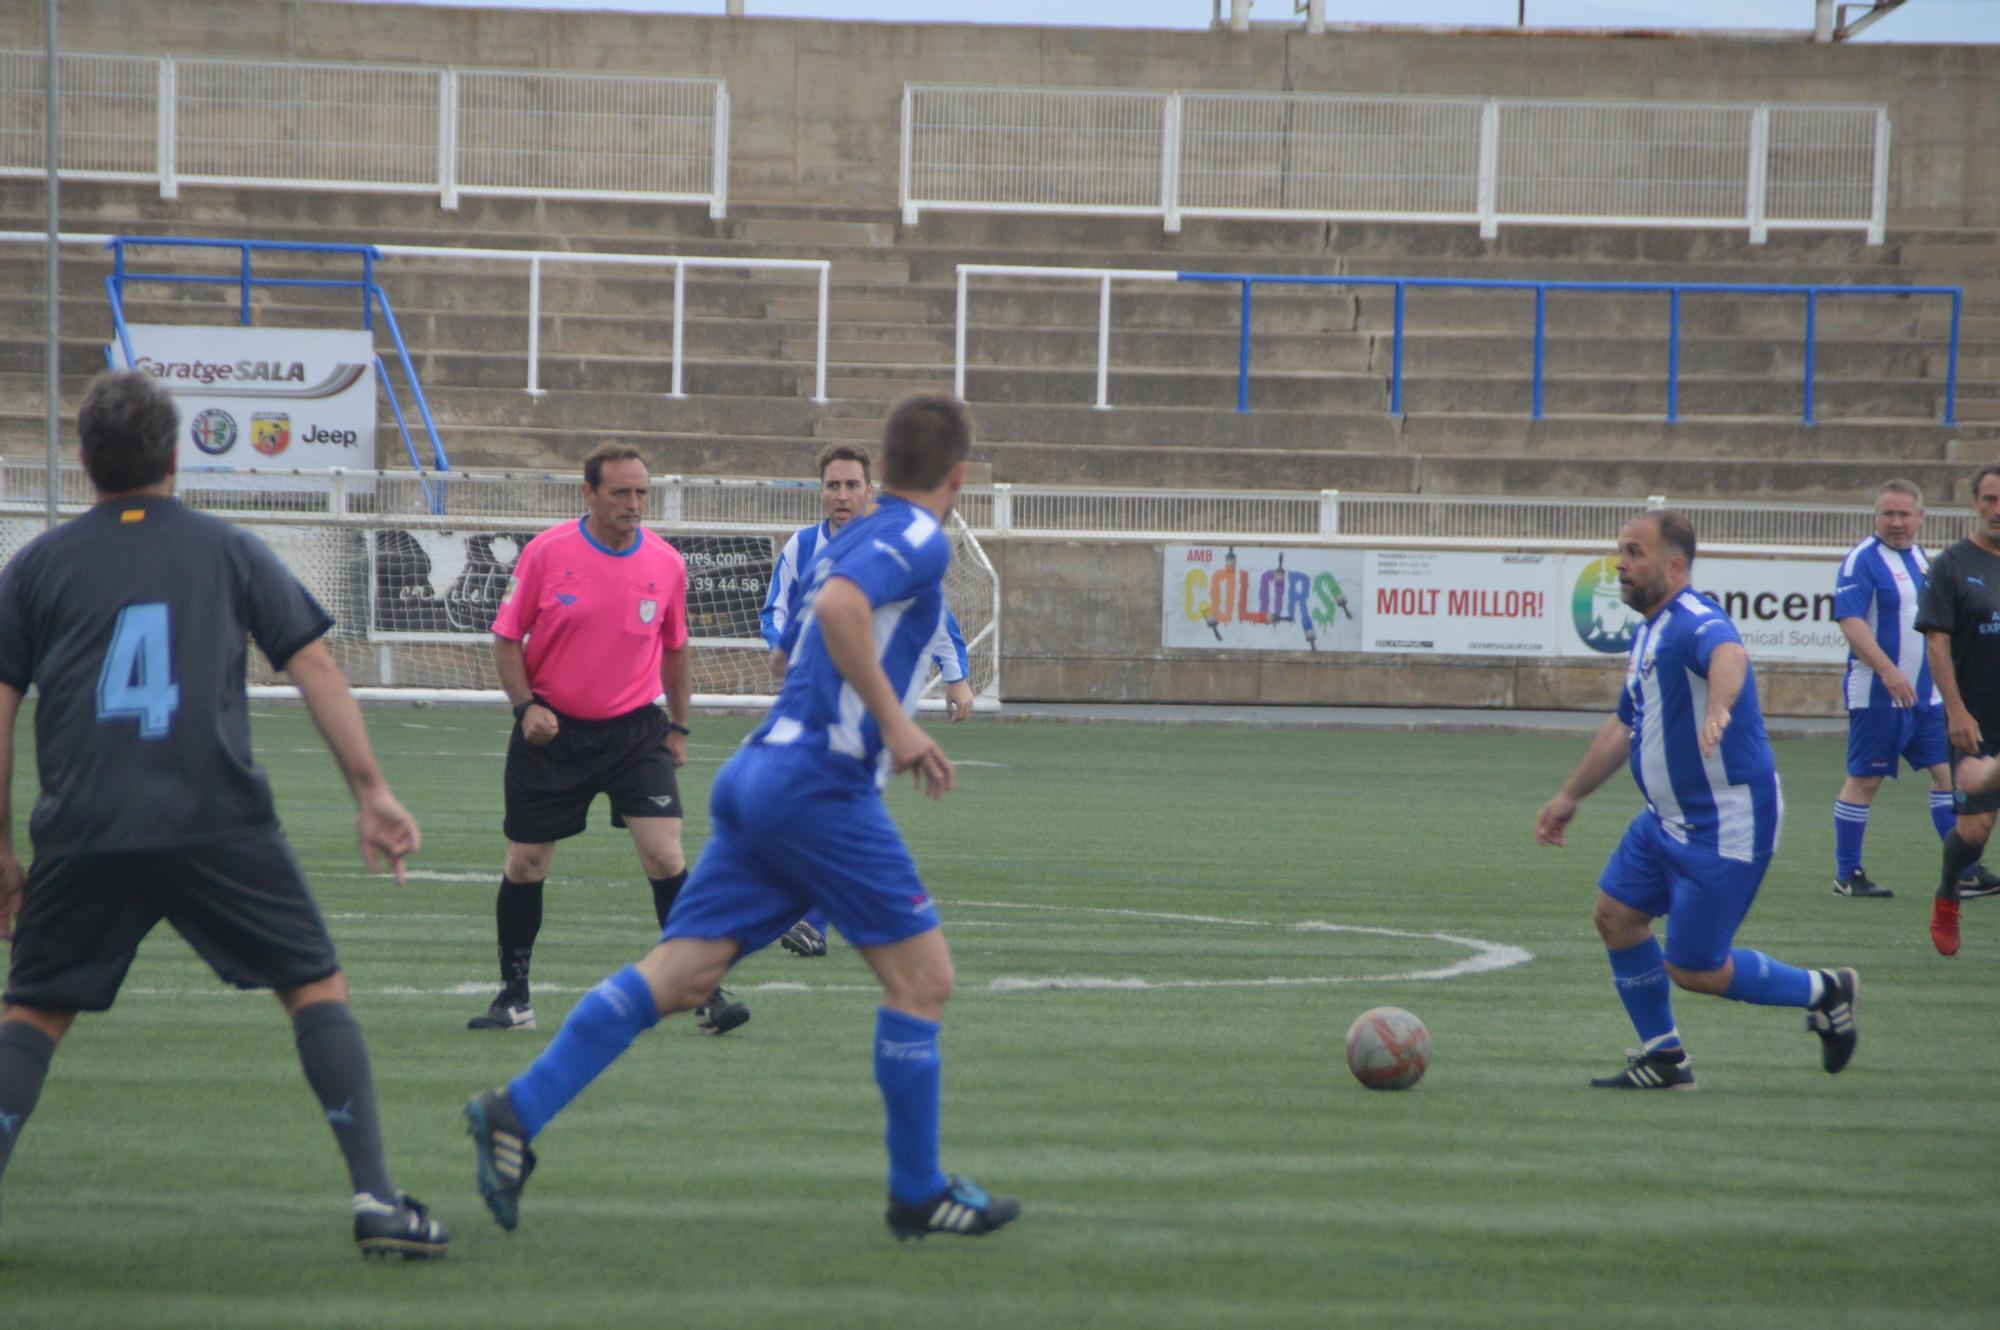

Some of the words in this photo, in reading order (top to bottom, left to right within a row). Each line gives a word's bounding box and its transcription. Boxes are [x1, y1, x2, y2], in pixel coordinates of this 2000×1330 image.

[302, 425, 358, 448] Jeep
[681, 552, 747, 567] eres.com
[1187, 549, 1213, 563] AMB
[696, 577, 713, 591] 39
[718, 578, 737, 592] 44
[741, 579, 759, 592] 58
[1184, 567, 1345, 632] COLORS
[1376, 588, 1441, 615] MOLT
[1447, 590, 1544, 618] MILLOR!
[1702, 590, 1837, 621] ncen
[1741, 629, 1784, 646] mical
[1789, 631, 1849, 648] Solutio
[96, 602, 179, 738] 4
